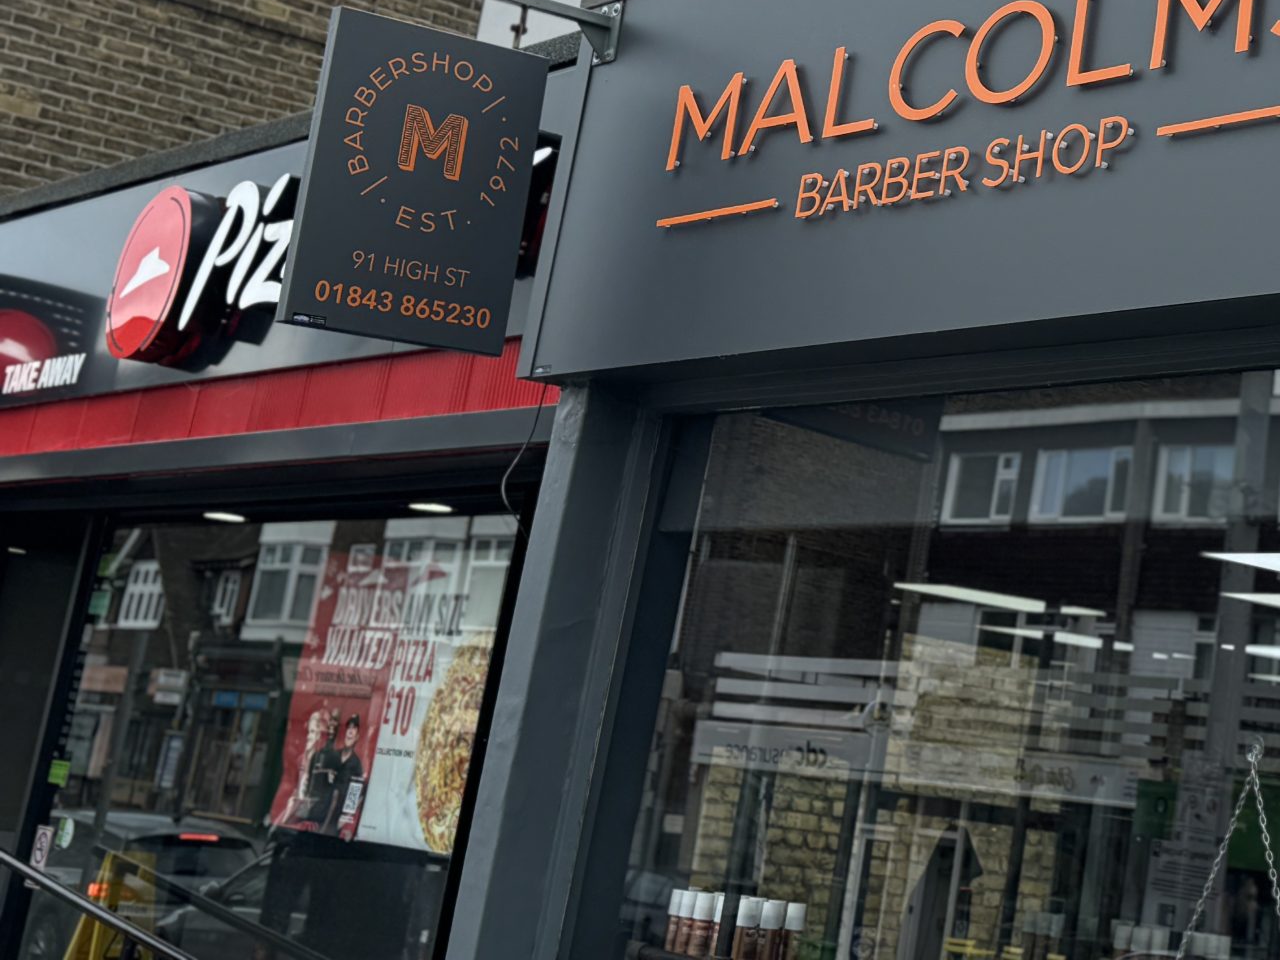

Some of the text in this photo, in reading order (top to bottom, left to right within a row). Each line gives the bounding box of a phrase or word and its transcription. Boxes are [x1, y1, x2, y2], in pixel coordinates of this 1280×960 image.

[344, 51, 494, 176] BARBERSHOP
[397, 103, 469, 182] M
[795, 115, 1129, 219] BARBER SHOP
[480, 136, 519, 207] 1972
[178, 172, 295, 332] Piz
[352, 250, 471, 288] 91 HIGH ST
[314, 279, 492, 329] 01843 865230
[2, 352, 87, 394] TAKE AWAY
[331, 586, 404, 630] DRIVERS
[434, 592, 470, 637] SIZE
[321, 626, 393, 670] WANTED
[392, 639, 437, 683] PIZZA
[382, 684, 416, 737] £10
